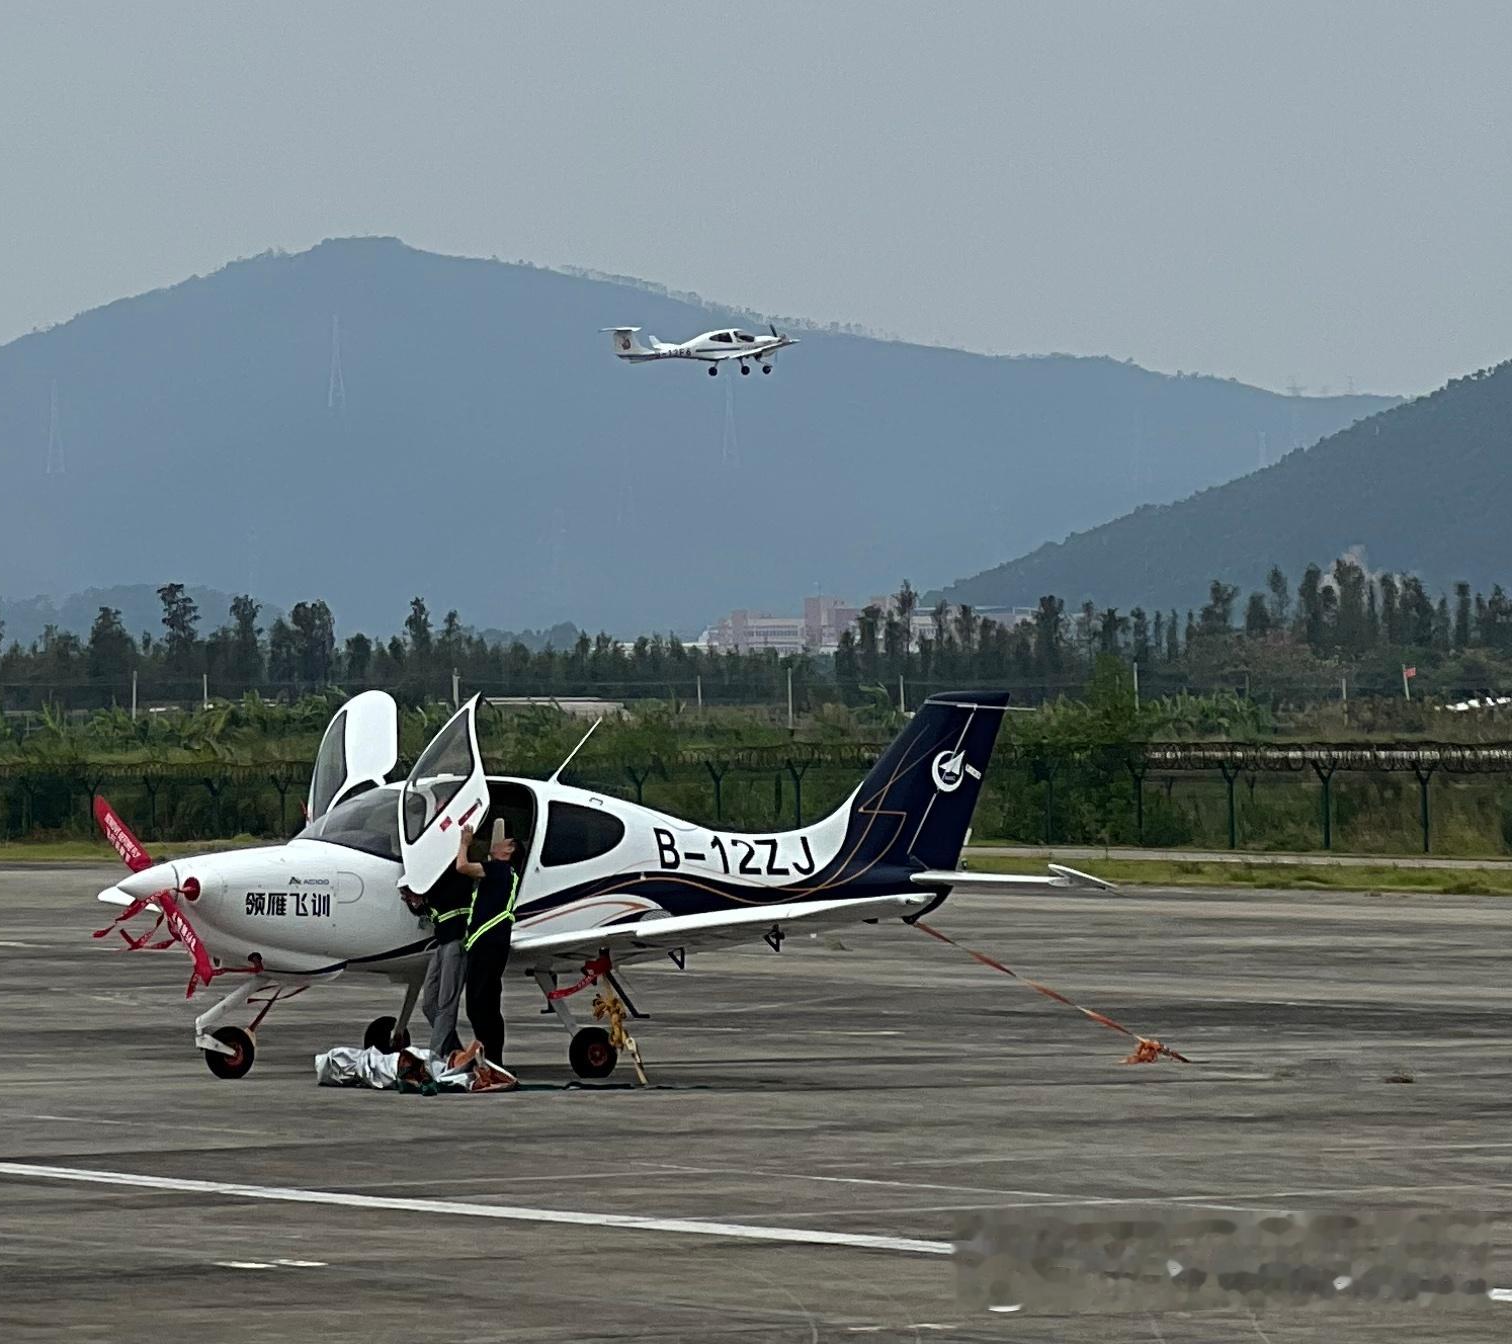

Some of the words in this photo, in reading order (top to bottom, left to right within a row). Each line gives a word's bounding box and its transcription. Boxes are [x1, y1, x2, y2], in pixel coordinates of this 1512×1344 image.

[653, 827, 815, 875] B-12ZJ
[245, 892, 330, 917] 领雁飞训
